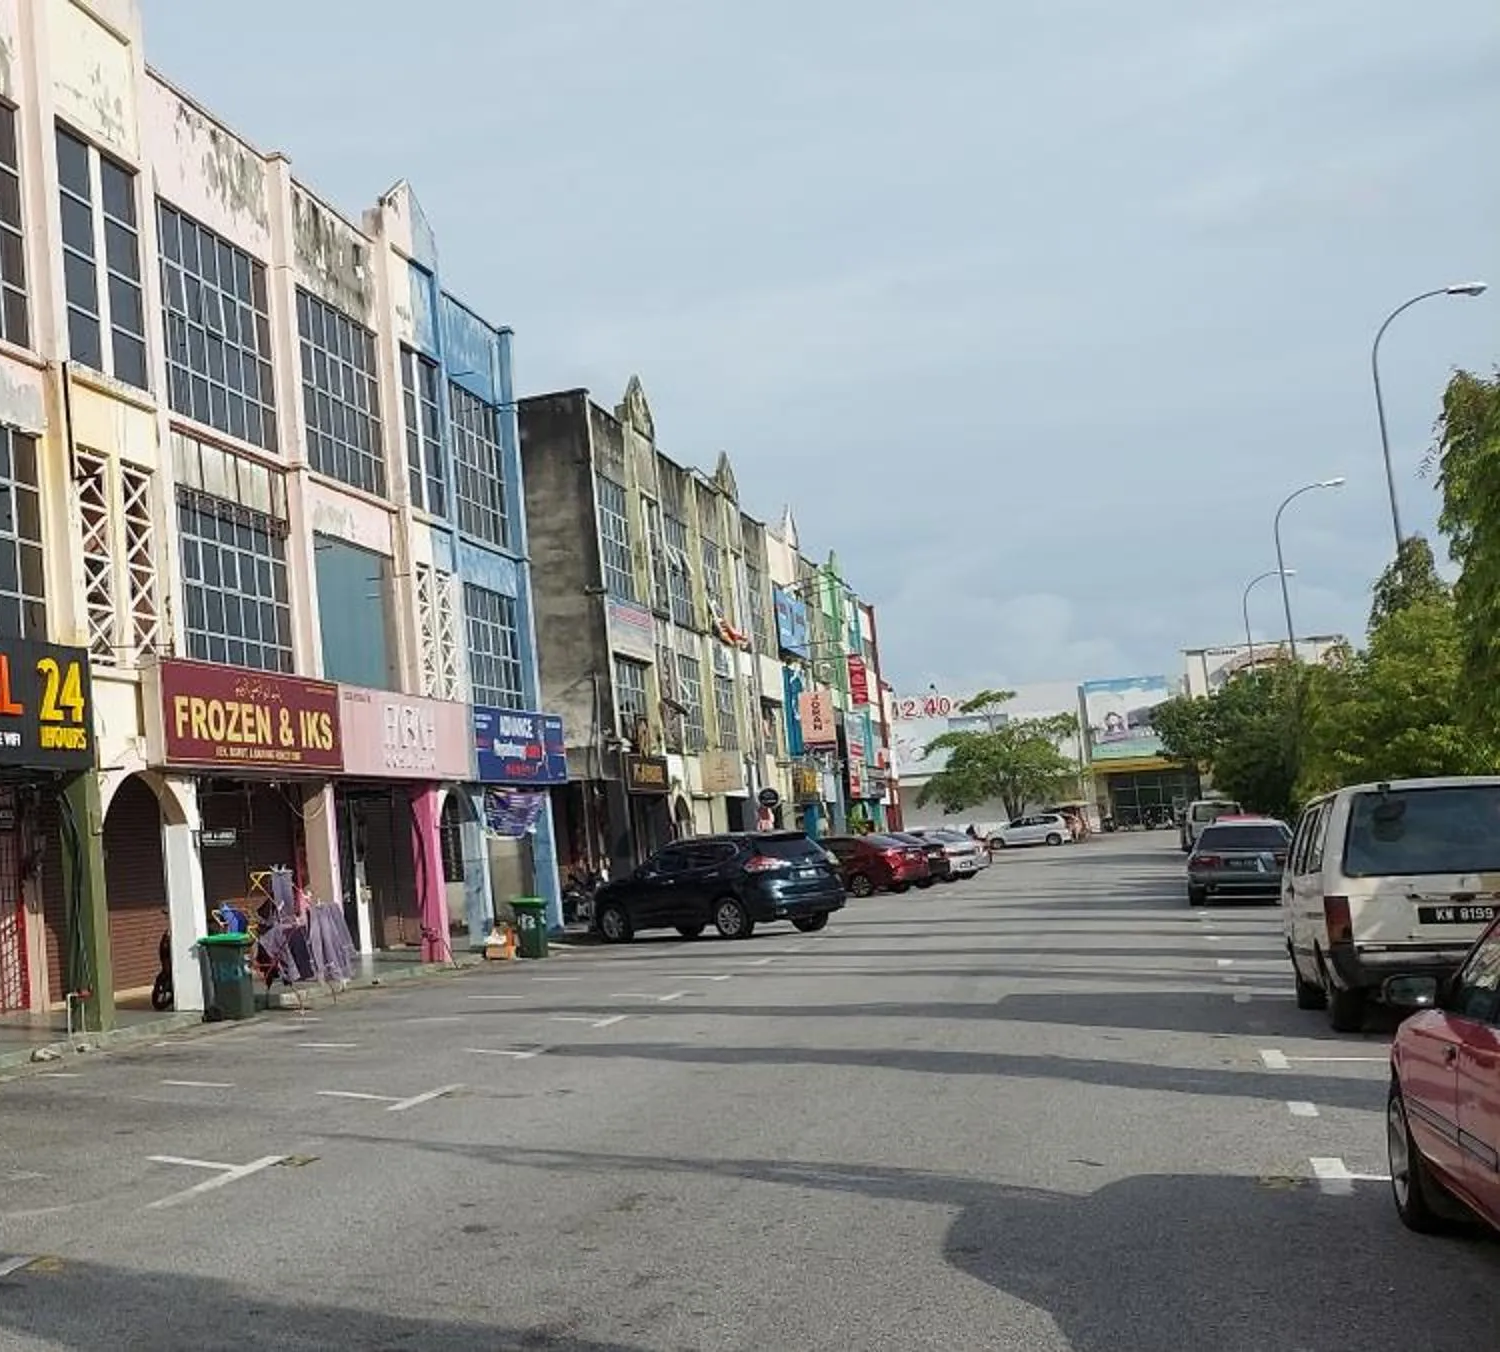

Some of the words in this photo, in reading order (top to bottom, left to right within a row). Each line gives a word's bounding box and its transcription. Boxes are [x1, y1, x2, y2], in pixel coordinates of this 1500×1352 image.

[36, 657, 85, 723] 24
[173, 695, 273, 746] FROZEN
[279, 706, 295, 747] &
[299, 710, 334, 751] IKS
